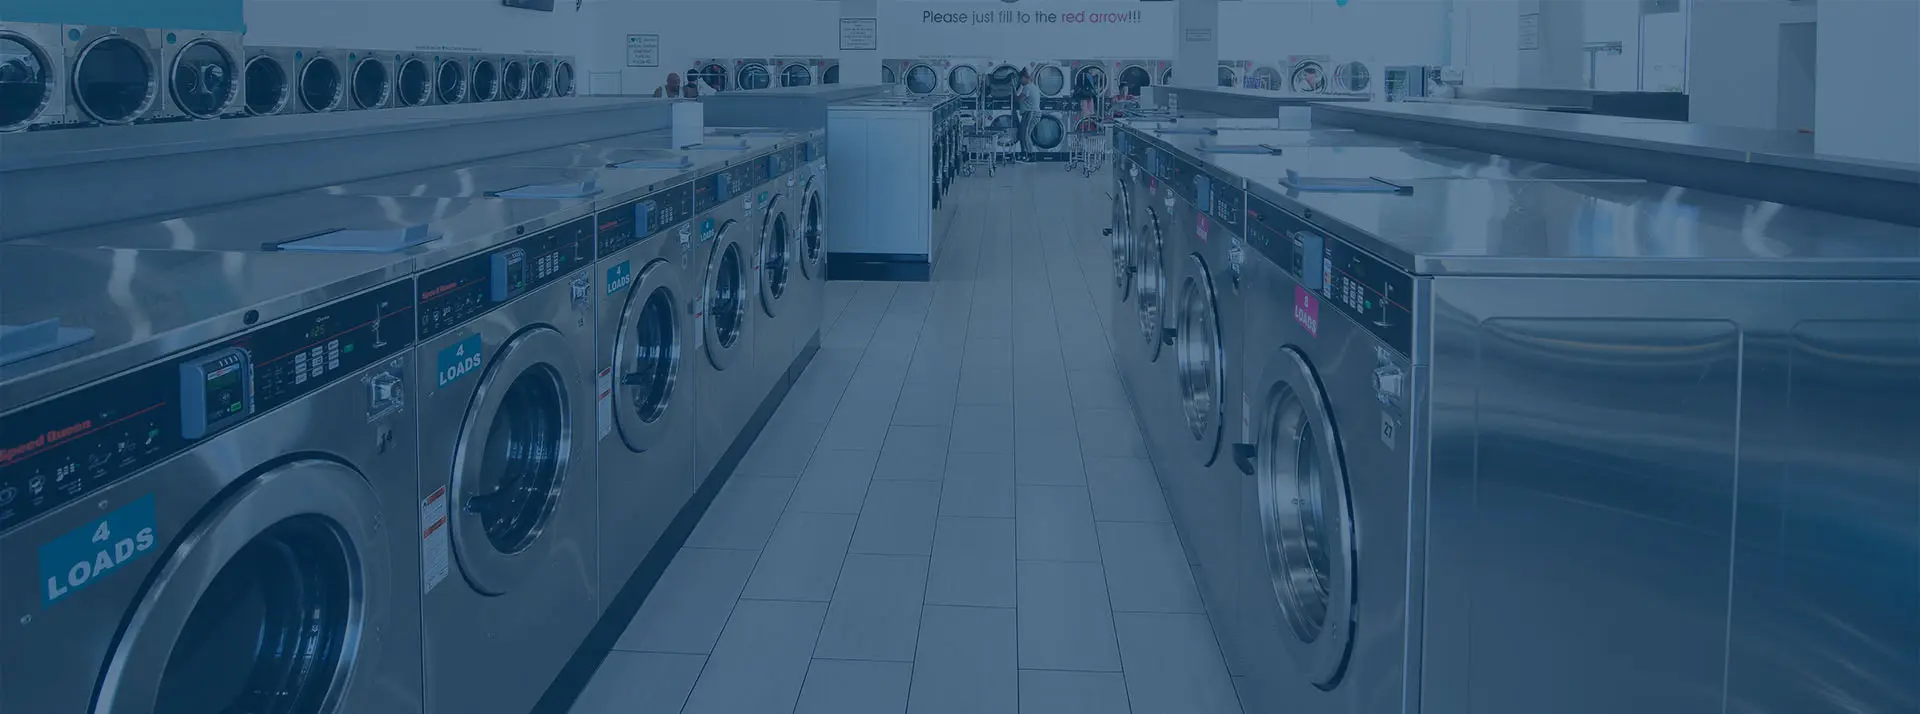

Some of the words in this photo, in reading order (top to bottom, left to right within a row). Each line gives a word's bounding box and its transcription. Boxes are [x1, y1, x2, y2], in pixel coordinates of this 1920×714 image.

[922, 10, 968, 23] Please
[971, 10, 993, 26] just
[998, 9, 1012, 23] fill
[1017, 9, 1030, 23] to
[1035, 10, 1057, 23] the
[1061, 10, 1085, 23] red
[1088, 10, 1141, 23] arrow!!!
[607, 274, 630, 293] LOADS
[1294, 304, 1317, 334] LOADS
[456, 343, 464, 356] 4
[439, 352, 481, 386] LOADS
[92, 520, 111, 543] 4
[47, 527, 155, 601] LOADS
